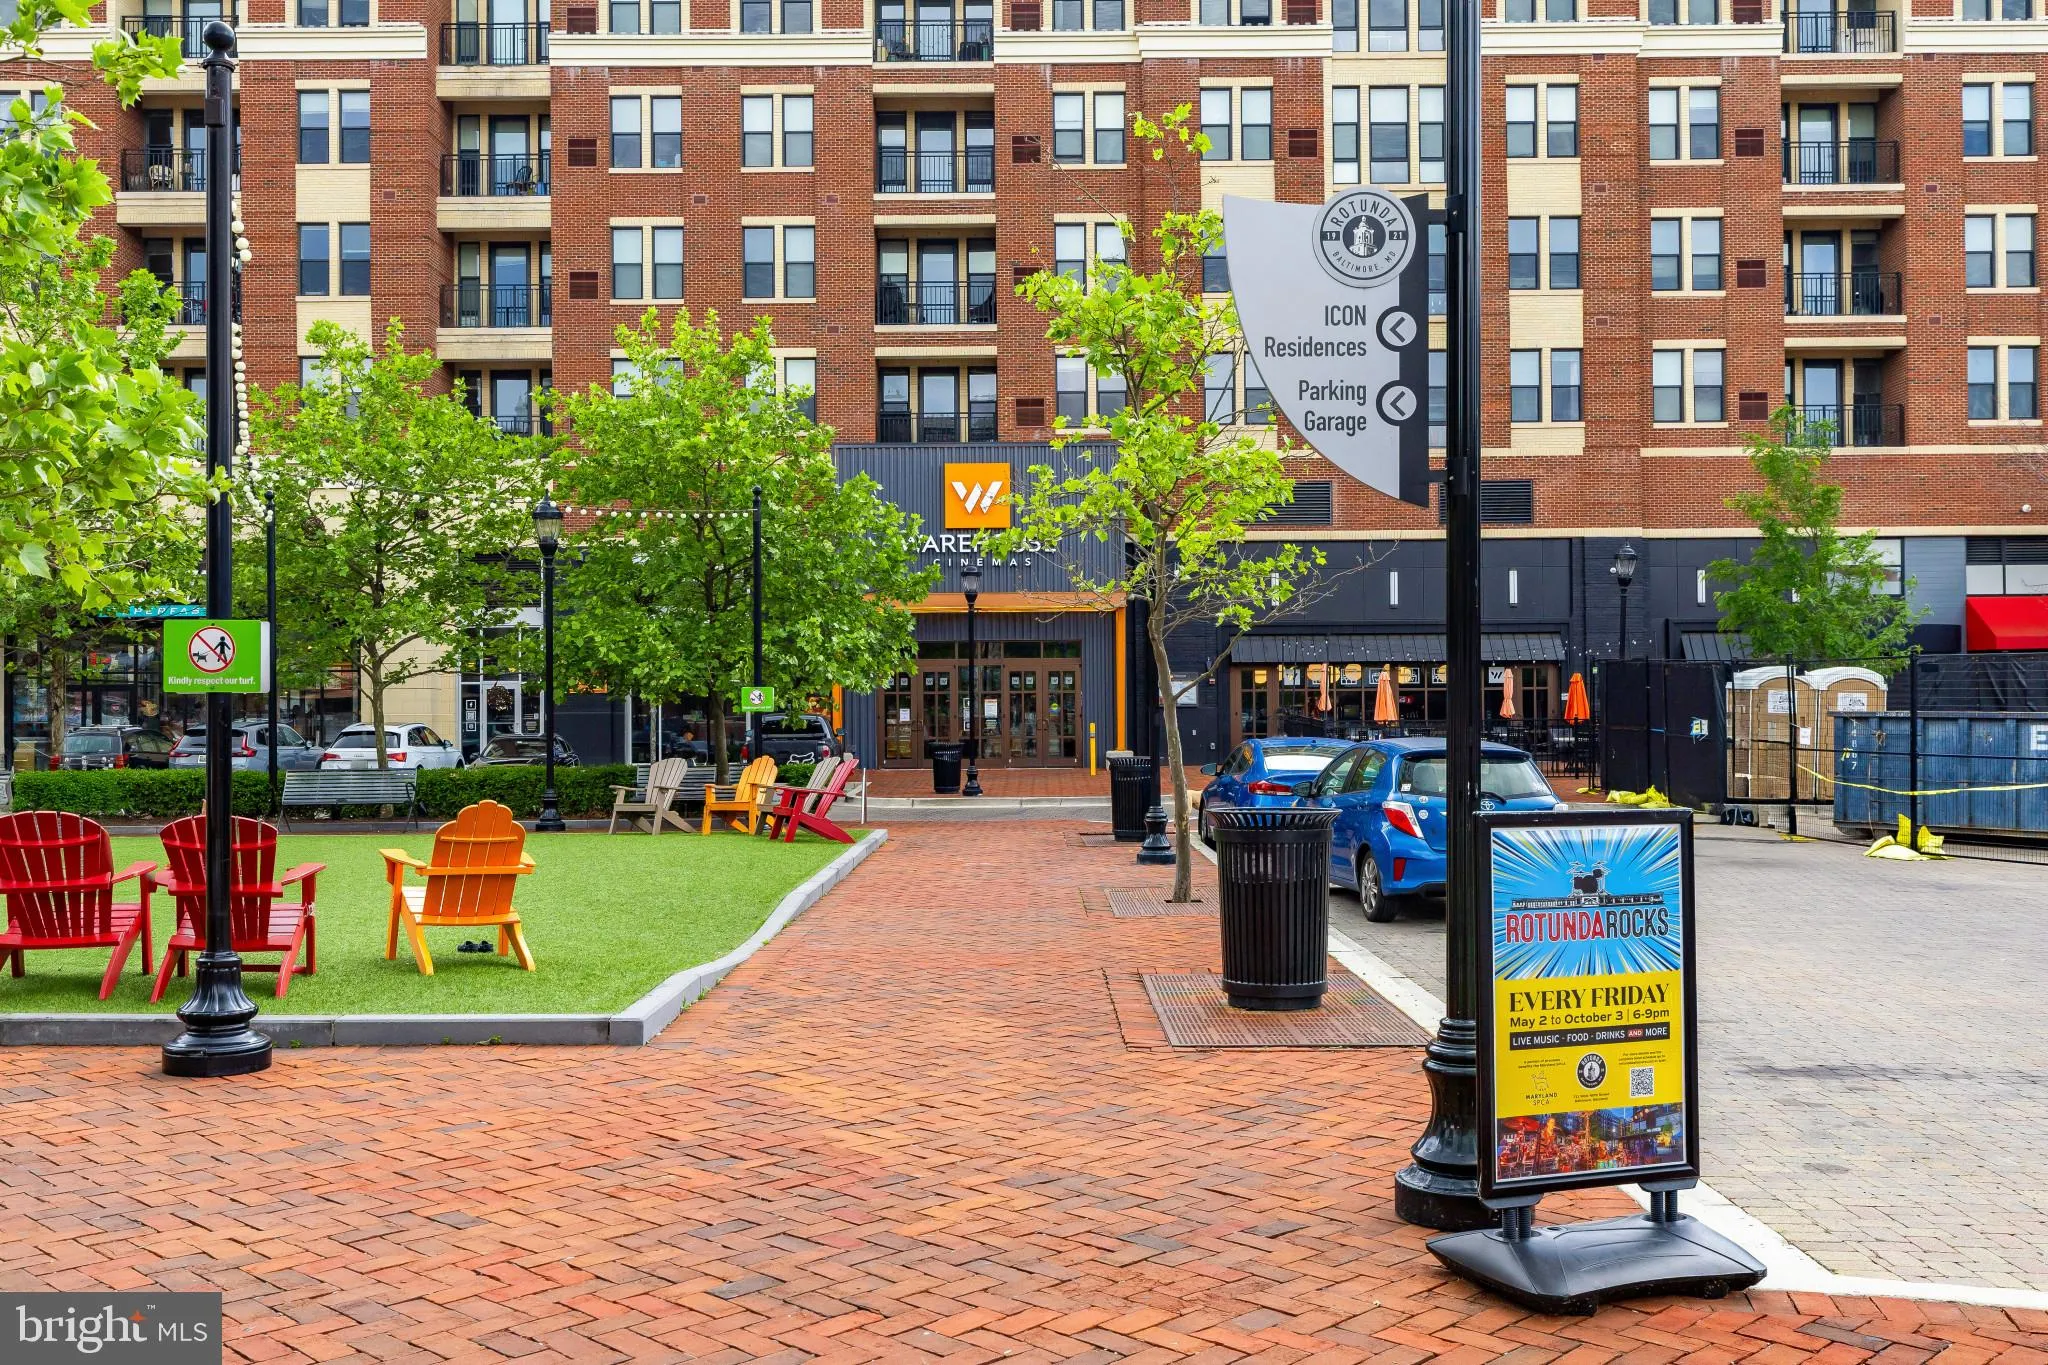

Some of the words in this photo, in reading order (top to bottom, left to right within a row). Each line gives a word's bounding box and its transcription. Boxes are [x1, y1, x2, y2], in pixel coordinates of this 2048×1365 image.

[1331, 199, 1398, 227] ROTUNDA
[1326, 232, 1336, 240] 19
[1393, 231, 1403, 239] 21
[1384, 250, 1396, 263] MD
[1324, 305, 1367, 326] ICON
[1264, 336, 1367, 358] Residences
[1299, 379, 1367, 406] Parking
[1304, 410, 1367, 437] Garage
[933, 558, 1032, 567] CINEMAS
[168, 676, 193, 686] Kindly
[193, 677, 223, 686] respect
[222, 677, 238, 685] our
[239, 676, 256, 685] turf.
[1505, 907, 1669, 944] ROTUNDAROCKS
[1510, 989, 1587, 1013] EVERY
[1592, 984, 1670, 1008] FRIDAY
[1510, 1017, 1535, 1029] May
[1539, 1016, 1548, 1026] 2
[1551, 1015, 1561, 1025] to
[1564, 1013, 1612, 1024] October
[1615, 1011, 1623, 1021] 3
[1632, 1008, 1670, 1020] 6-9pm
[1512, 1036, 1531, 1046] LIVE
[1533, 1034, 1560, 1045] MUSIC
[1567, 1032, 1589, 1042] FOOD
[1596, 1030, 1625, 1040] DRINKS
[1628, 1029, 1643, 1037] AND
[1645, 1027, 1668, 1037] MORE
[1525, 1092, 1558, 1100] MARYLAND
